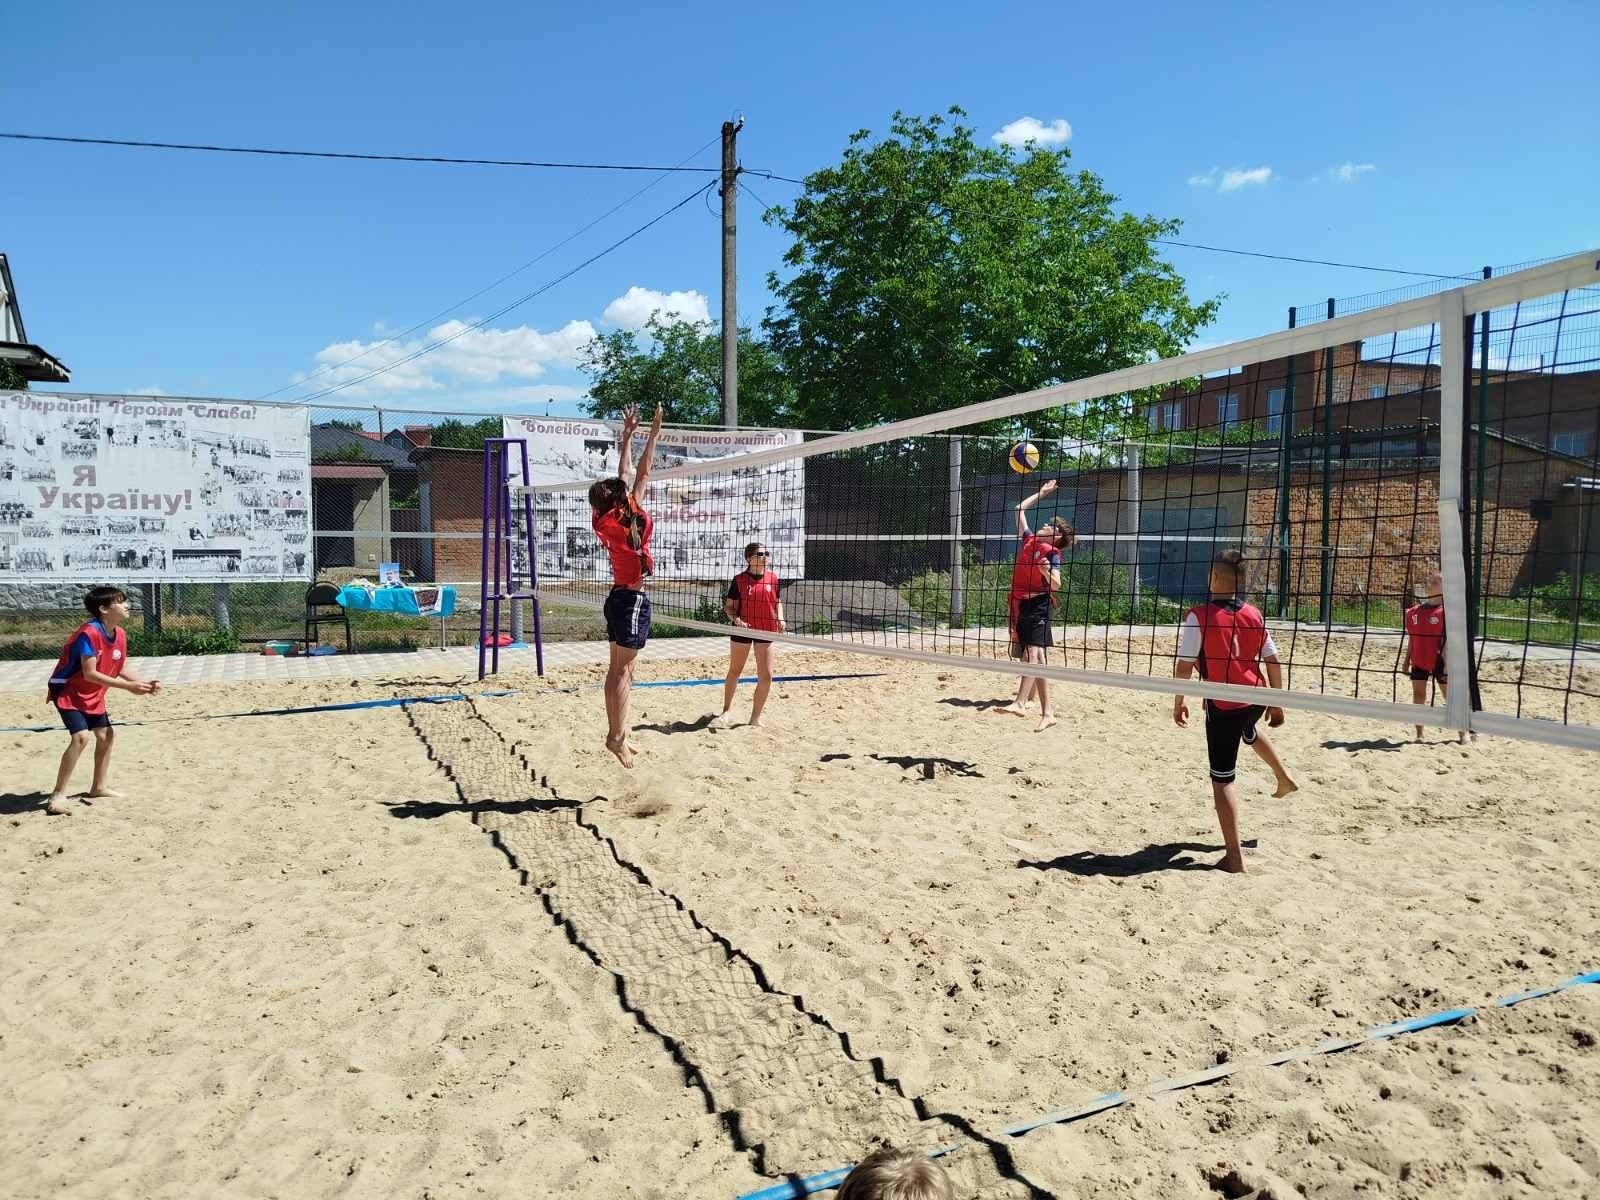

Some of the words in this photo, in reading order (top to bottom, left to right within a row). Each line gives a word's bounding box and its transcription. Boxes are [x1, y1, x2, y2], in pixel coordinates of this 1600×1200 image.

[108, 399, 183, 418] Героям
[187, 404, 257, 420] Слава!
[521, 420, 599, 437] Волейбол
[681, 434, 732, 445] нашого
[72, 464, 97, 487] Я
[37, 485, 193, 516] Україну!
